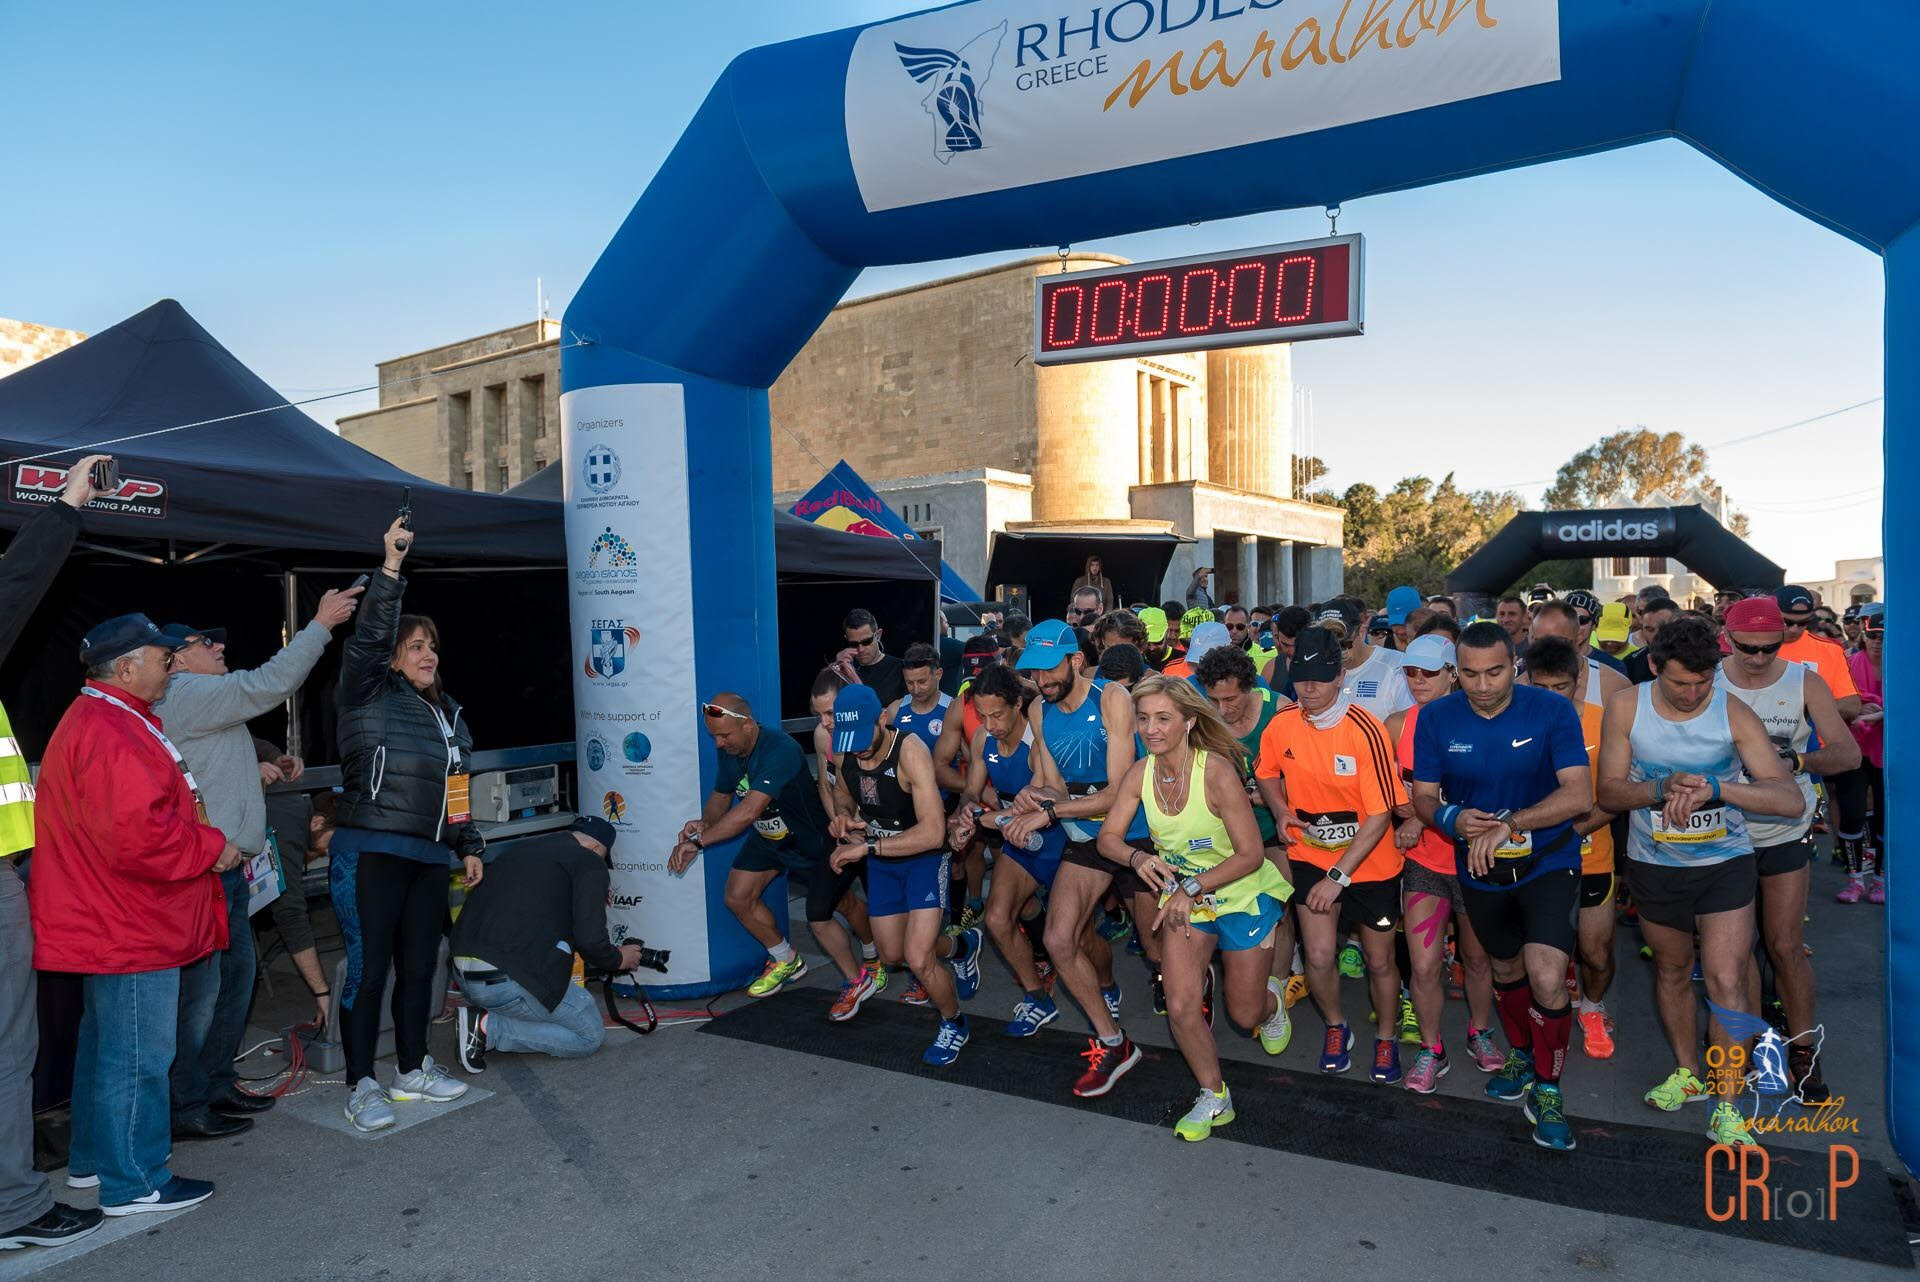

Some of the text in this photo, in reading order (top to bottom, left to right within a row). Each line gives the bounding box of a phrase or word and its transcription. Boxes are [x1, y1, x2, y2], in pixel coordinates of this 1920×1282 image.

[1102, 0, 1498, 112] marathon
[1016, 55, 1109, 92] GREECE
[1048, 256, 1316, 346] 00:00:00
[577, 418, 624, 431] Organizers
[15, 463, 164, 502] WP
[16, 491, 161, 516] WORK CING PARTS
[795, 489, 882, 516] Red Bull
[1558, 519, 1659, 542] adidas
[611, 589, 635, 597] Aegean
[591, 619, 624, 629] ΣΕΓΑΣ
[594, 711, 606, 720] the
[607, 712, 646, 722] support
[649, 710, 661, 721] of
[1317, 825, 1356, 841] 2230
